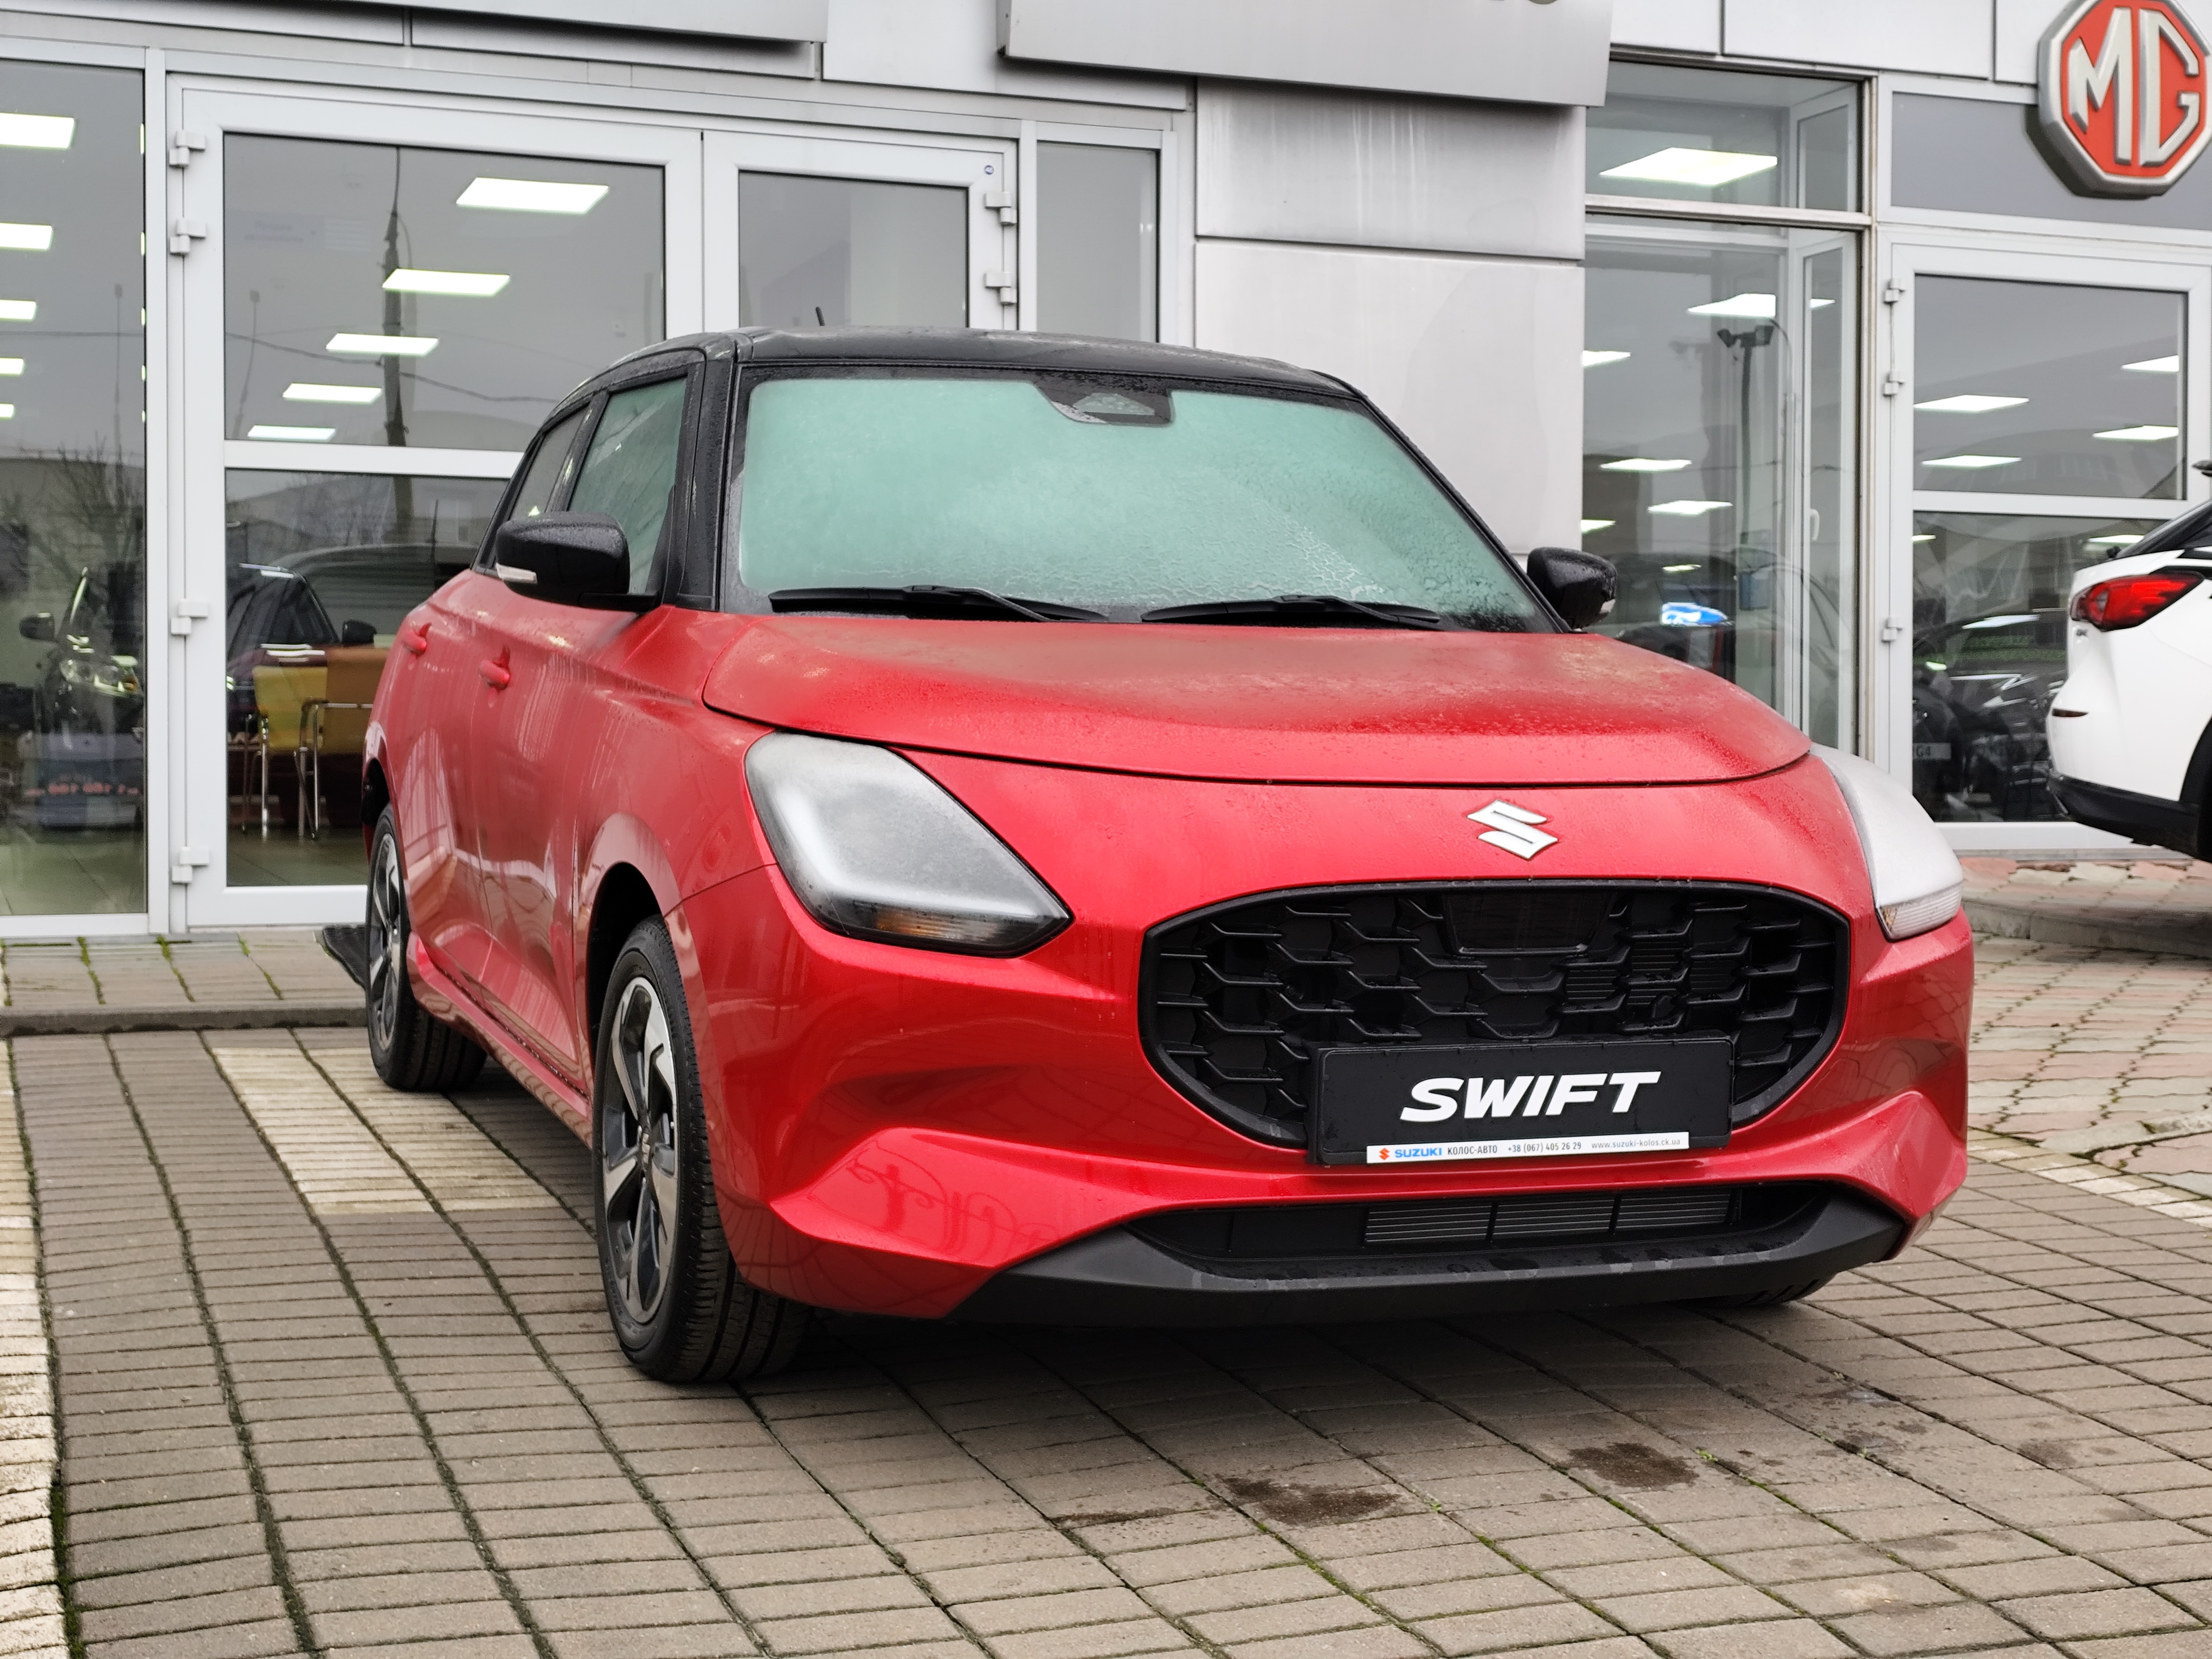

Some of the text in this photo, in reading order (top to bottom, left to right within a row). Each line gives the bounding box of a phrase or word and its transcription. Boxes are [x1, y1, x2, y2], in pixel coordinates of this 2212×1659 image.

[2069, 6, 2200, 167] MG
[1400, 1071, 1661, 1122] SWIFT
[1394, 1139, 1681, 1158] SUZUKI КОЛОС-АВТО +38 (067) 405 26 29 www.suzuki-kolos.ck.ua
